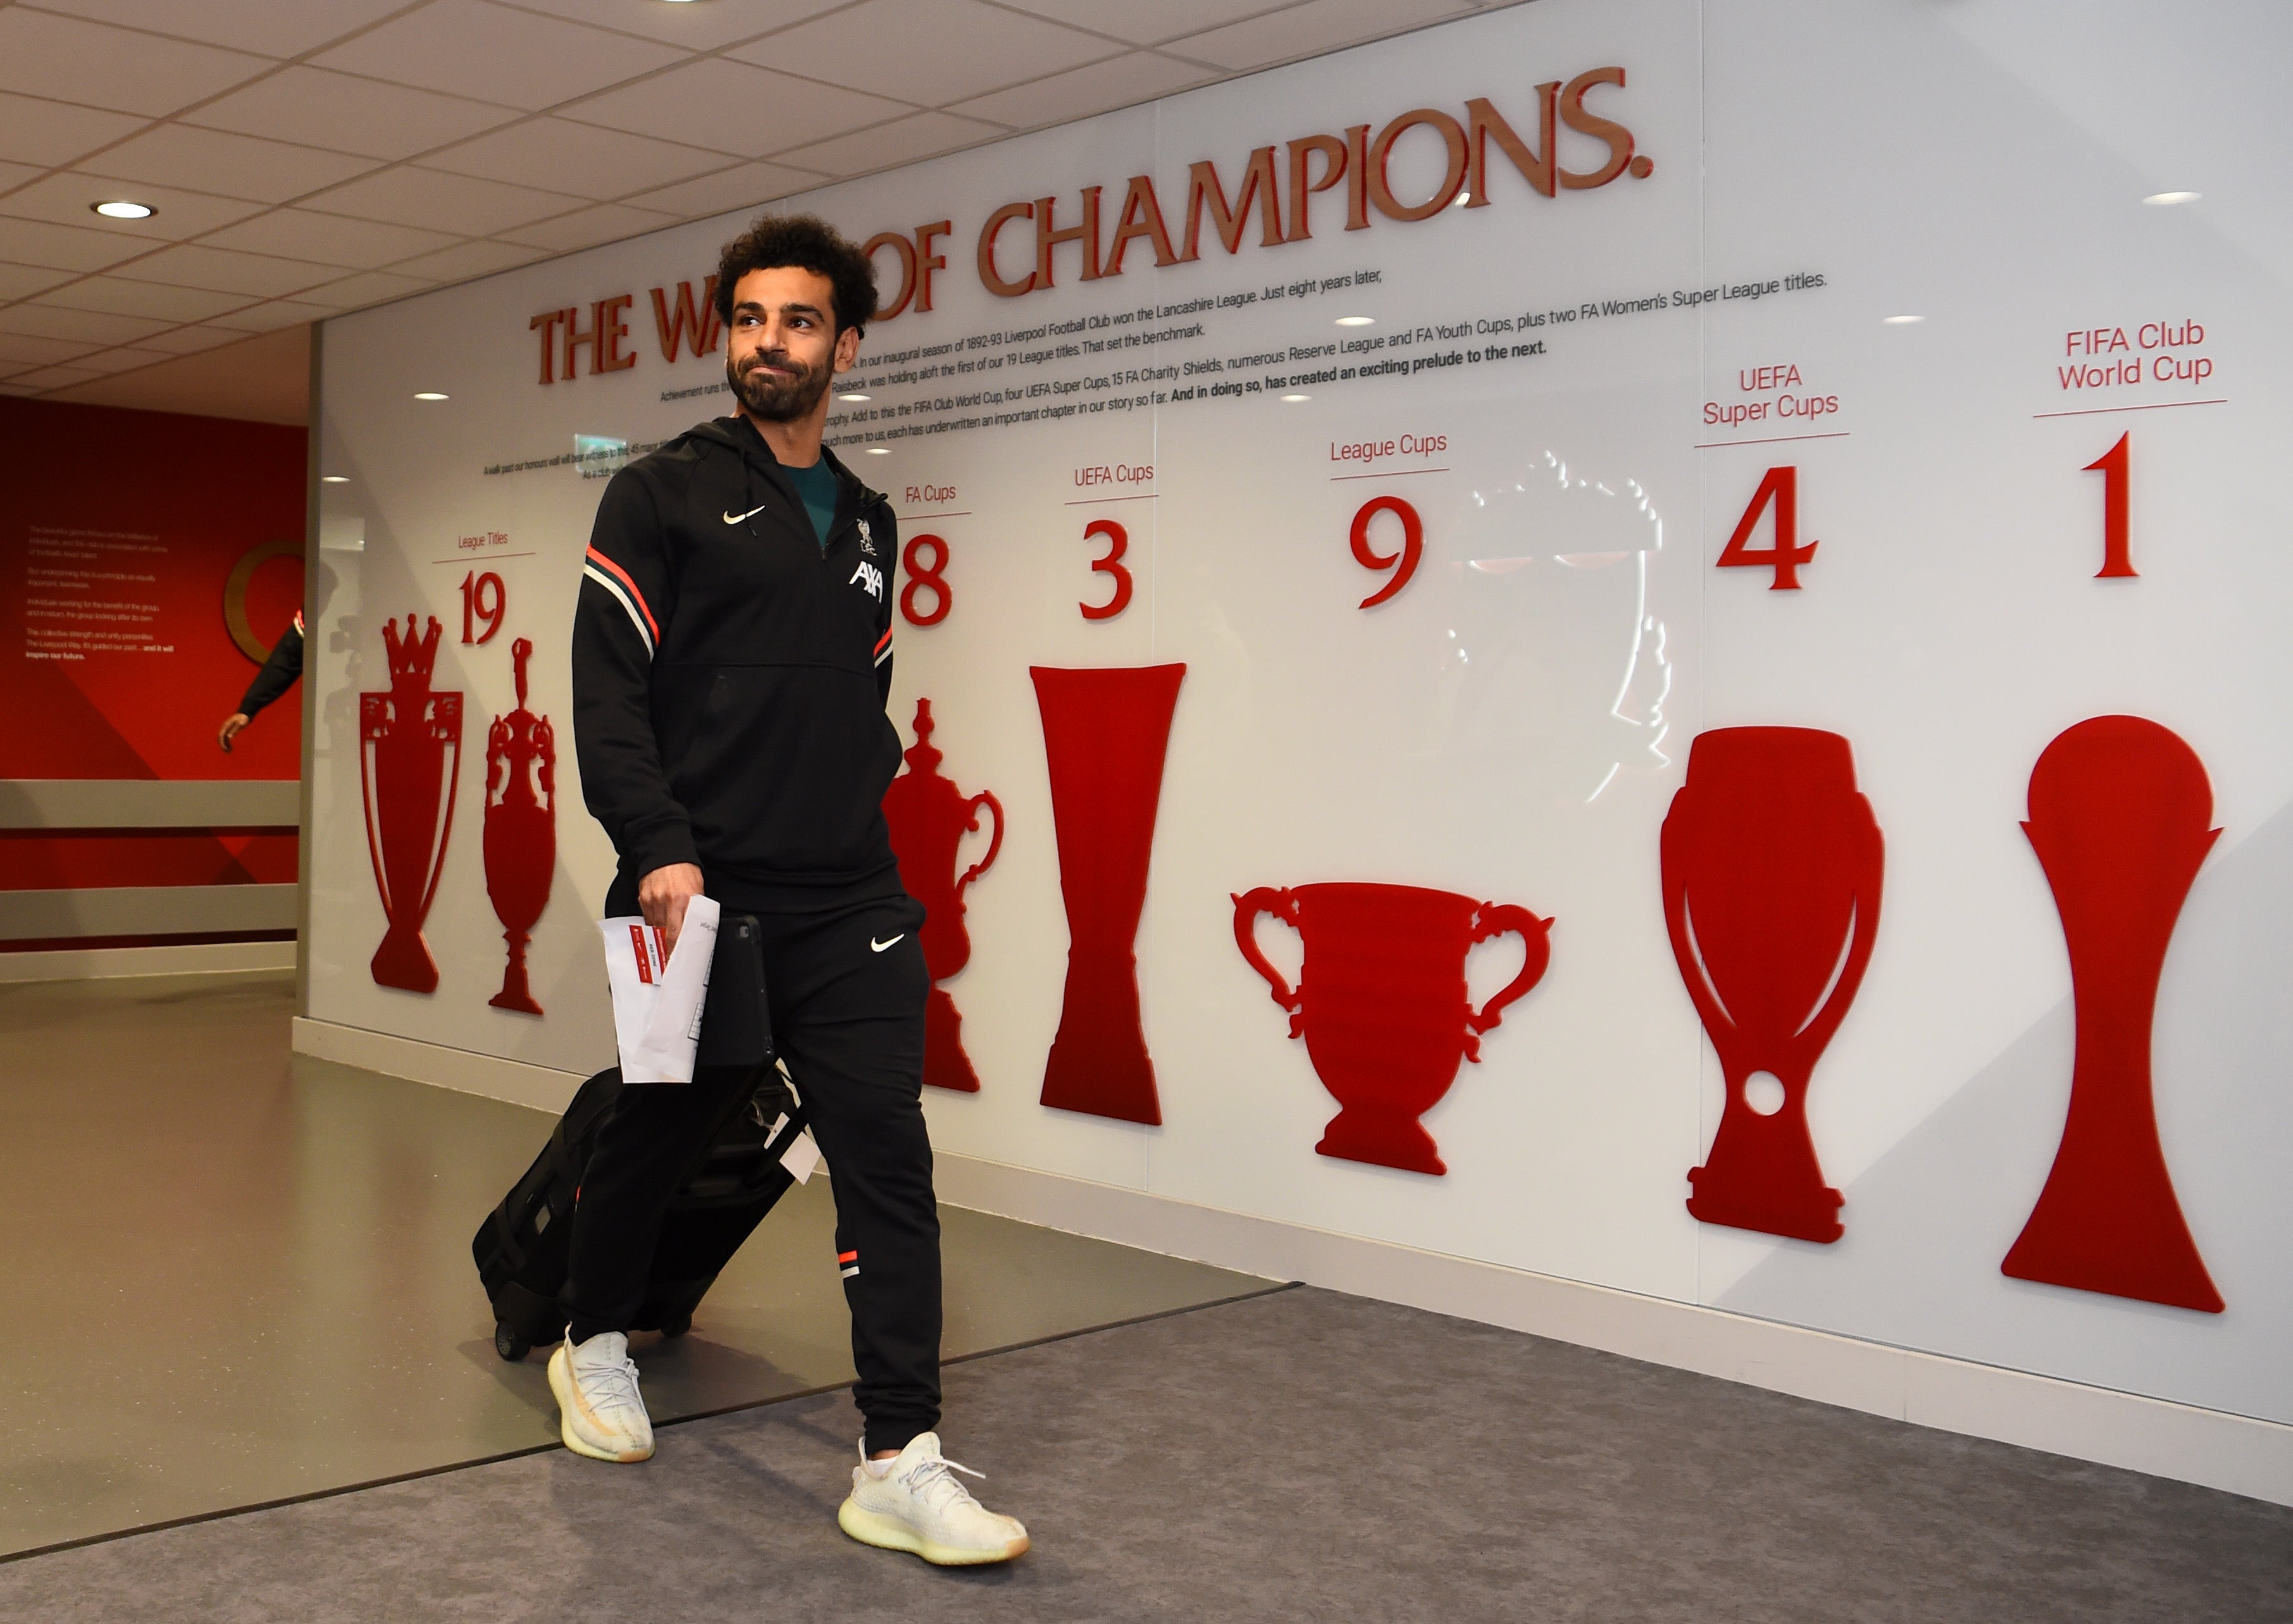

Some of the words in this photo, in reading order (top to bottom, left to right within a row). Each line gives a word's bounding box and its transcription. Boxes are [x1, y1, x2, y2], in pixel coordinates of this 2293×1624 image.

[530, 294, 637, 384] THE
[861, 220, 952, 321] OF
[977, 66, 1653, 297] CHAMPIONS.
[704, 385, 719, 394] runs
[859, 358, 867, 368] In
[868, 356, 882, 366] our
[883, 347, 919, 364] inaugural
[922, 344, 952, 357] season
[954, 338, 964, 352] of
[967, 333, 1002, 349] 1892-93
[1005, 325, 1047, 344] Liverpool
[1048, 318, 1086, 335] Football
[1088, 314, 1110, 329] Club
[1113, 313, 1134, 325] won
[1137, 308, 1153, 321] the
[1157, 299, 1214, 318] Lancashire
[1216, 292, 1258, 308] League.
[1260, 285, 1286, 301] Just
[1288, 280, 1316, 298] eight
[1320, 276, 1352, 294] years
[1355, 271, 1383, 285] later,
[831, 378, 867, 393] Raisbeck
[869, 377, 886, 387] was
[888, 371, 917, 384] holding
[919, 366, 938, 380] aloft
[941, 364, 955, 376] the
[957, 361, 974, 373] first
[977, 357, 988, 370] of
[989, 357, 1004, 368] our
[1007, 353, 1017, 365] 19
[1019, 350, 1054, 364] League
[1055, 344, 1081, 358] titles.
[1082, 340, 1105, 354] That
[1107, 337, 1122, 350] set
[1124, 334, 1141, 347] the
[1143, 323, 1205, 344] benchmark.
[852, 409, 868, 422] Add
[869, 410, 878, 419] to
[881, 407, 895, 418] this
[897, 404, 911, 416] the
[914, 400, 933, 413] FIFA
[934, 397, 954, 411] Club
[955, 393, 981, 407] World
[983, 392, 1004, 405] Cup,
[1005, 388, 1024, 400] four
[1026, 383, 1051, 398] UEFA
[1053, 381, 1081, 395] Super
[1083, 377, 1111, 390] Cups,
[1112, 373, 1124, 385] 15
[1126, 371, 1139, 383] FA
[1141, 366, 1180, 381] Charity
[1183, 358, 1224, 375] Shields,
[1227, 352, 1285, 369] numerous
[1289, 345, 1336, 360] Reserve
[1340, 338, 1384, 354] League
[1388, 330, 1412, 347] and
[1416, 328, 1434, 342] FA
[1434, 321, 1472, 339] Youth
[1477, 319, 1514, 335] Cups,
[1517, 313, 1546, 332] plus
[1549, 310, 1577, 323] two
[1581, 304, 1600, 319] FA
[1602, 294, 1668, 316] Women's
[1672, 289, 1718, 307] Super
[1723, 281, 1779, 299] League
[1784, 273, 1828, 290] titles.
[2066, 327, 2130, 356] FIFA
[2139, 318, 2205, 349] Club
[843, 435, 863, 445] more
[865, 432, 873, 442] to
[887, 426, 907, 438] each
[909, 425, 924, 436] has
[925, 418, 981, 433] underwritten
[982, 417, 994, 426] an
[995, 409, 1040, 426] important
[1041, 405, 1077, 419] chapter
[1078, 404, 1087, 413] in
[1090, 402, 1107, 412] our
[1109, 398, 1134, 411] story
[1136, 396, 1148, 406] so
[1171, 386, 1195, 402] And
[1196, 388, 1207, 398] in
[1210, 381, 1243, 397] doing
[1245, 381, 1263, 393] so,
[1265, 376, 1287, 389] has
[1289, 367, 1336, 386] created
[1340, 368, 1357, 380] an
[1359, 359, 1410, 376] exciting
[1413, 350, 1463, 374] prelude
[1467, 350, 1482, 363] to
[1484, 345, 1508, 361] the
[1512, 340, 1547, 357] next.
[1741, 364, 1803, 391] UEFA
[2058, 357, 2141, 390] World
[2153, 356, 2213, 385] Cup
[1703, 402, 1771, 427] Super
[1777, 394, 1839, 420] Cups
[1075, 466, 1112, 486] UEFA
[1116, 464, 1154, 485] Cups
[1331, 440, 1395, 462] League
[1400, 434, 1447, 457] Cups
[906, 487, 921, 503] FA
[924, 485, 956, 504] Cups
[1716, 466, 1820, 590] 4
[2081, 430, 2141, 578] 1
[458, 536, 485, 550] League
[487, 531, 509, 545] Titles
[1079, 519, 1133, 619] 3
[1350, 495, 1423, 609] 9
[459, 570, 506, 644] 19
[849, 561, 883, 603] AXA
[900, 534, 952, 626] 8
